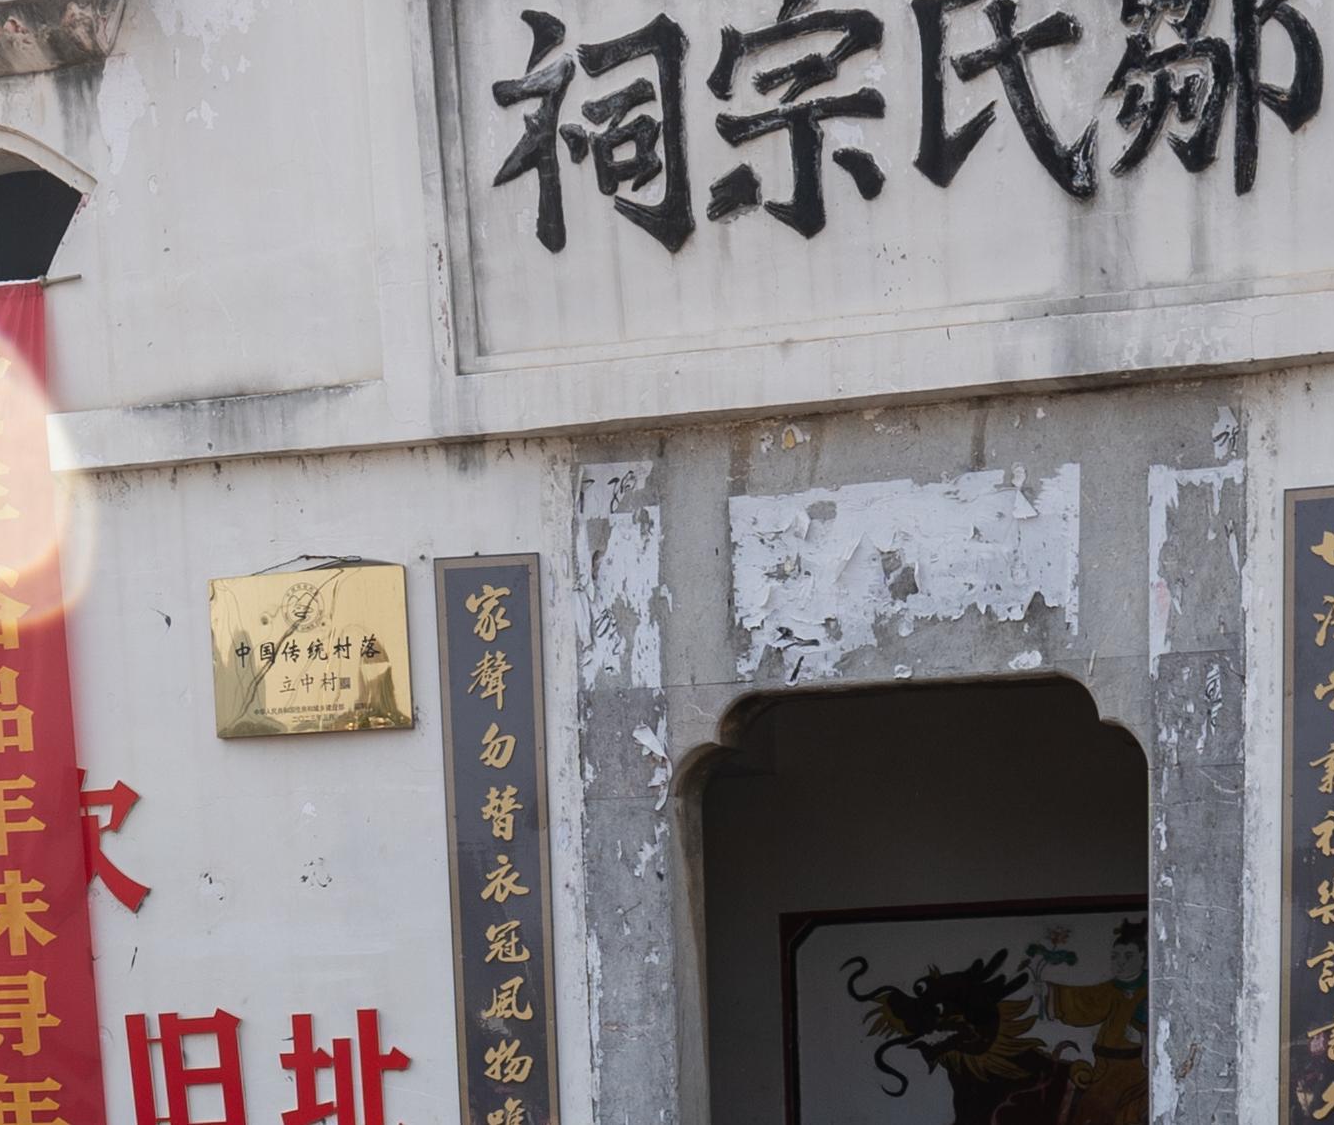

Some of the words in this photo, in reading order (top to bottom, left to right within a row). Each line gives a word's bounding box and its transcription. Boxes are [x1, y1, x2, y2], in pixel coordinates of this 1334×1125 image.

[235, 634, 381, 668] 中国传统村落
[279, 672, 339, 693] 立中村
